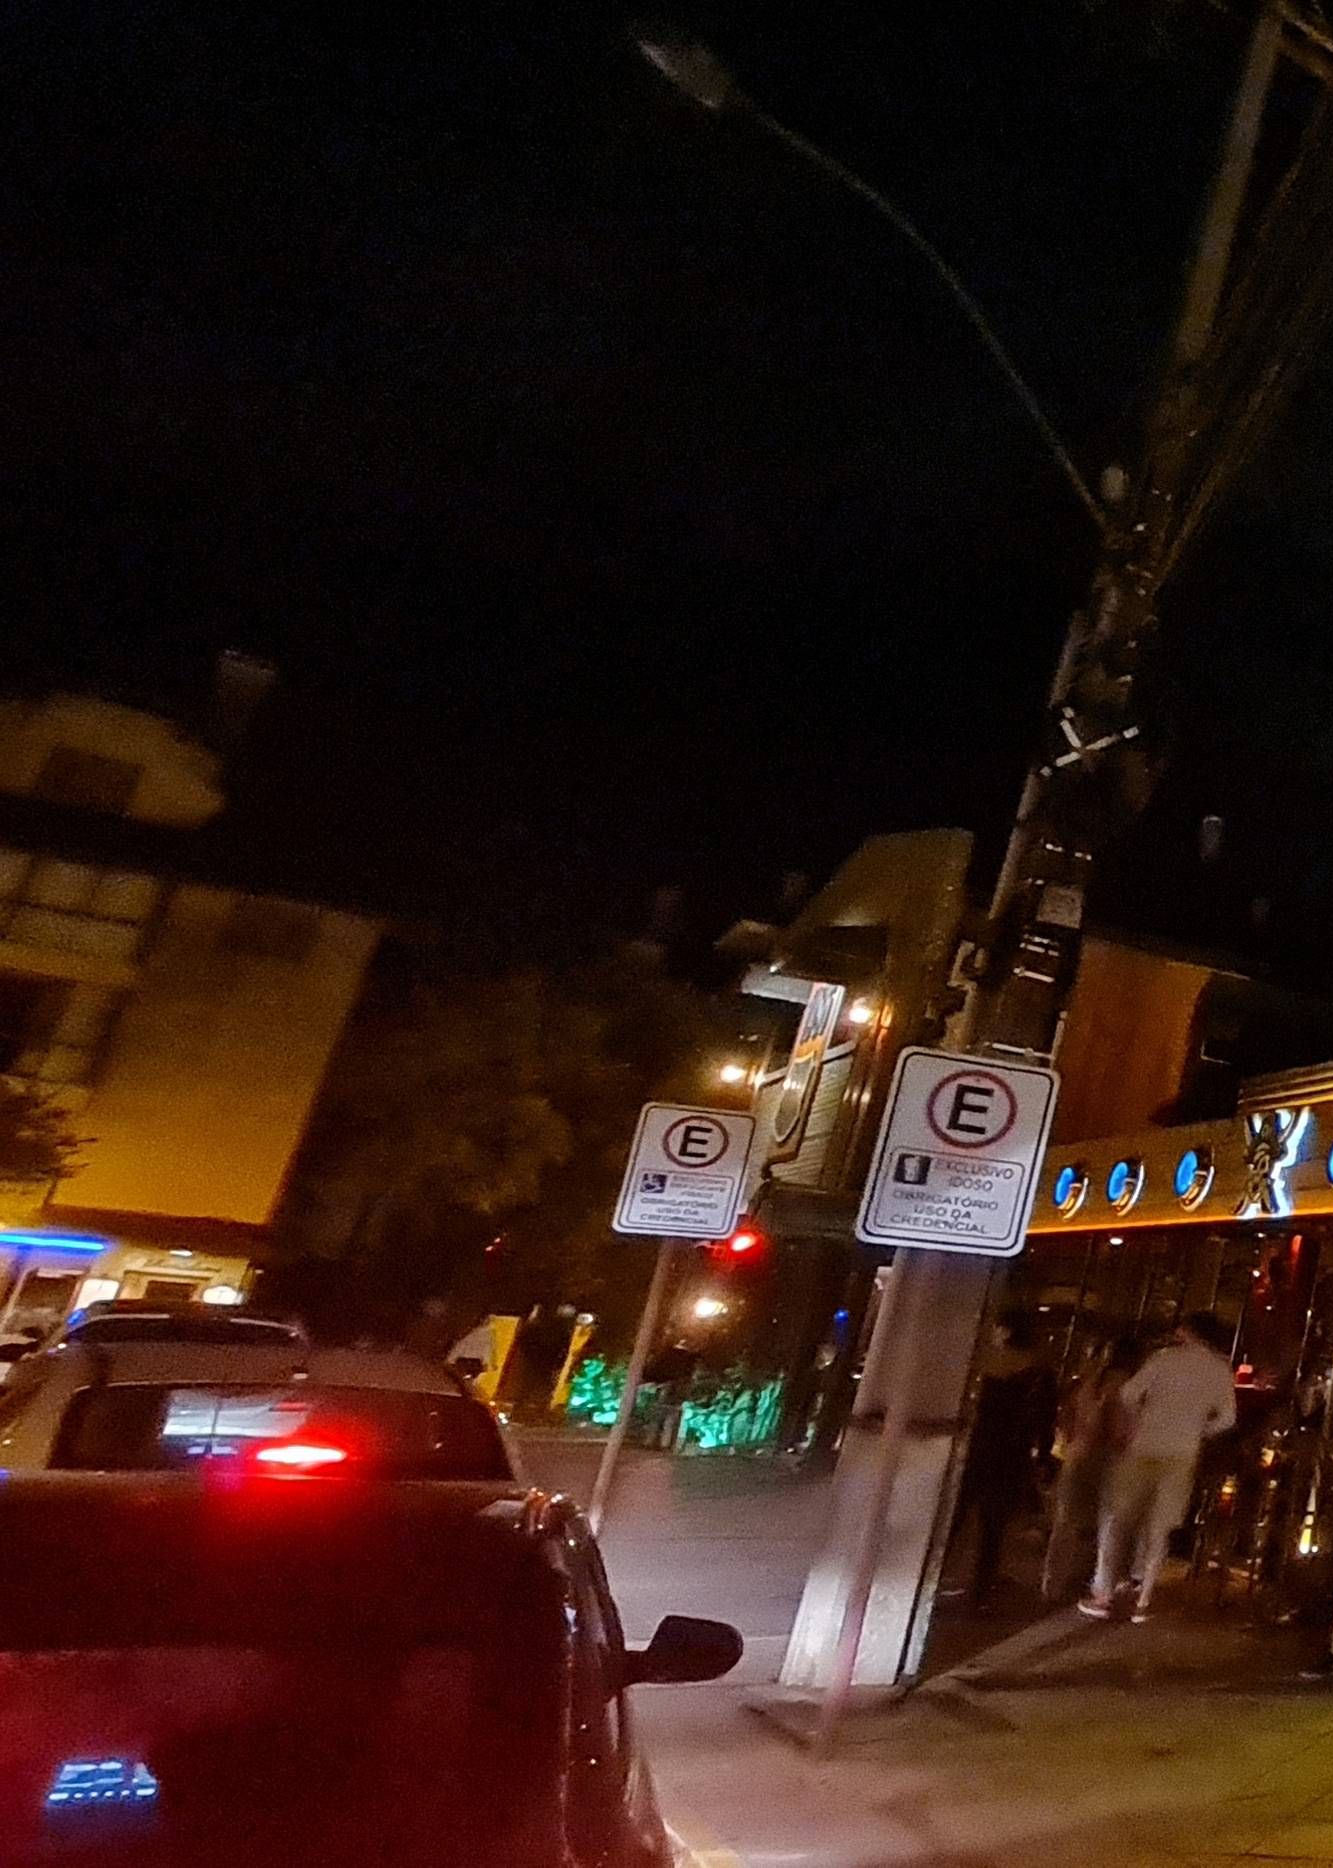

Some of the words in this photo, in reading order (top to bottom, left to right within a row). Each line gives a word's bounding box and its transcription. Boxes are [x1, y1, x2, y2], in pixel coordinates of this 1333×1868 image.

[946, 1083, 995, 1135] E
[678, 1125, 713, 1158] E
[934, 1158, 1015, 1180] EXCLUSIVO
[949, 1175, 993, 1192] IDOSO
[914, 1204, 948, 1217] USO
[890, 1215, 988, 1234] CREDENCIAL
